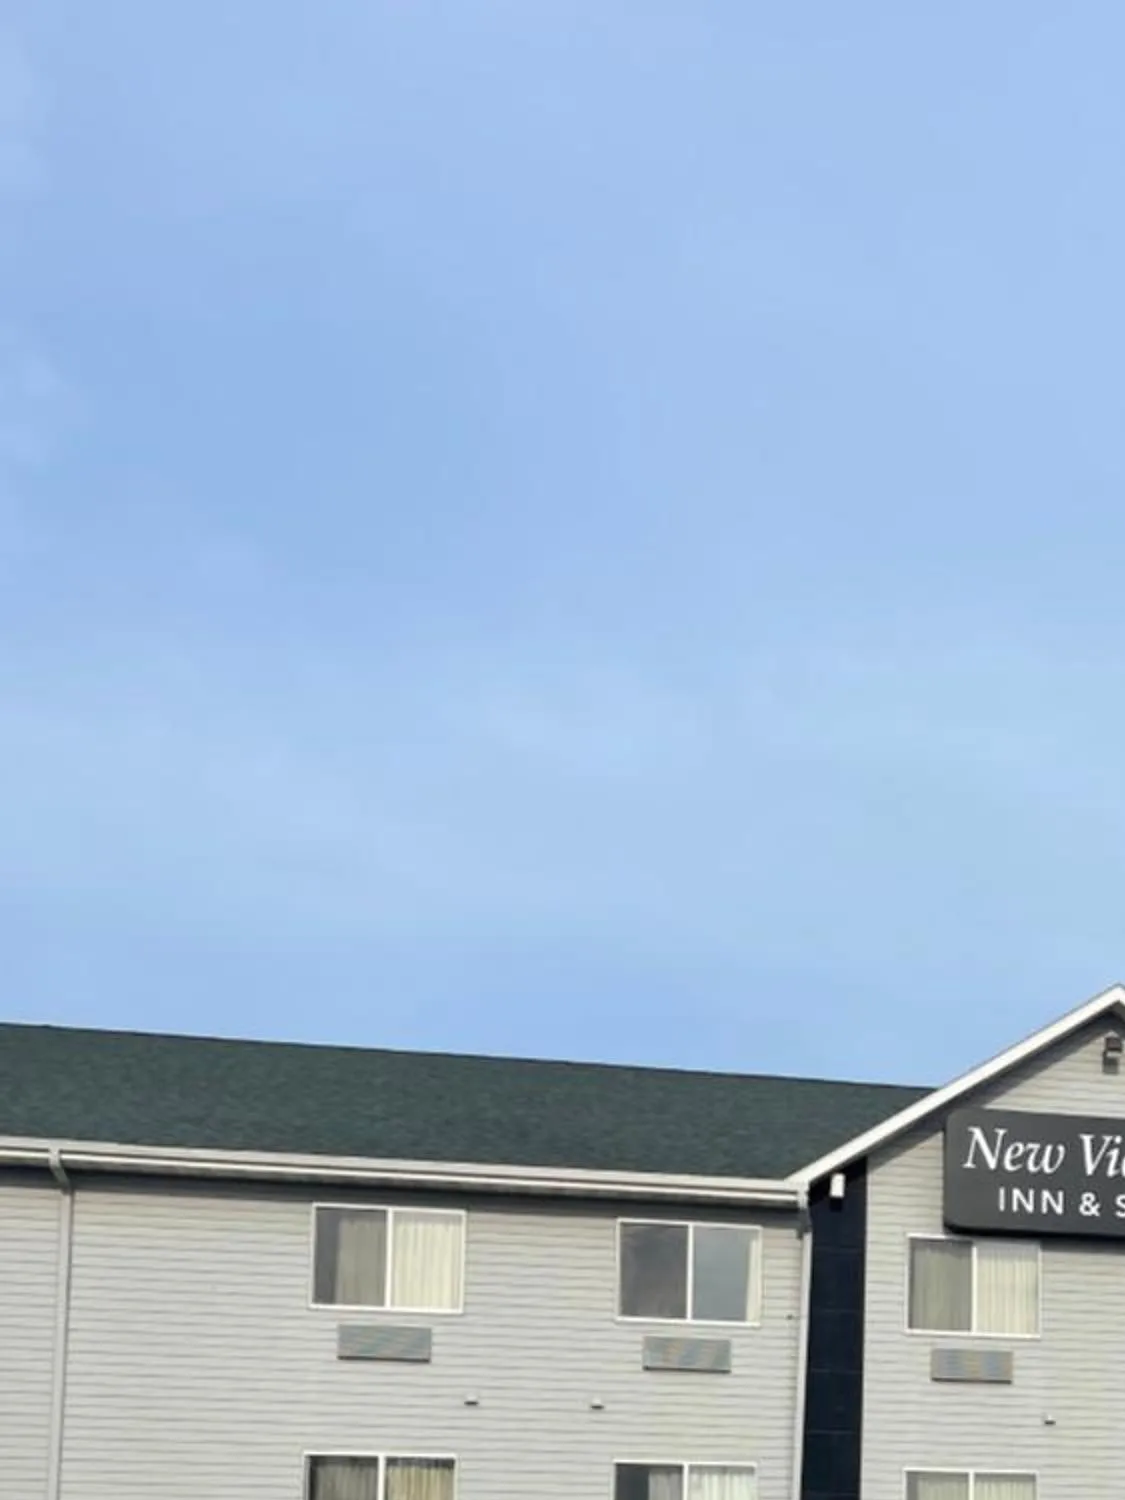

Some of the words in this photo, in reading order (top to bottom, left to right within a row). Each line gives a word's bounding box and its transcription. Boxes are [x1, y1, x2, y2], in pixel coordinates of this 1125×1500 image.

[963, 1126, 1065, 1174] New
[999, 1186, 1065, 1215] INN
[1079, 1192, 1101, 1217] &
